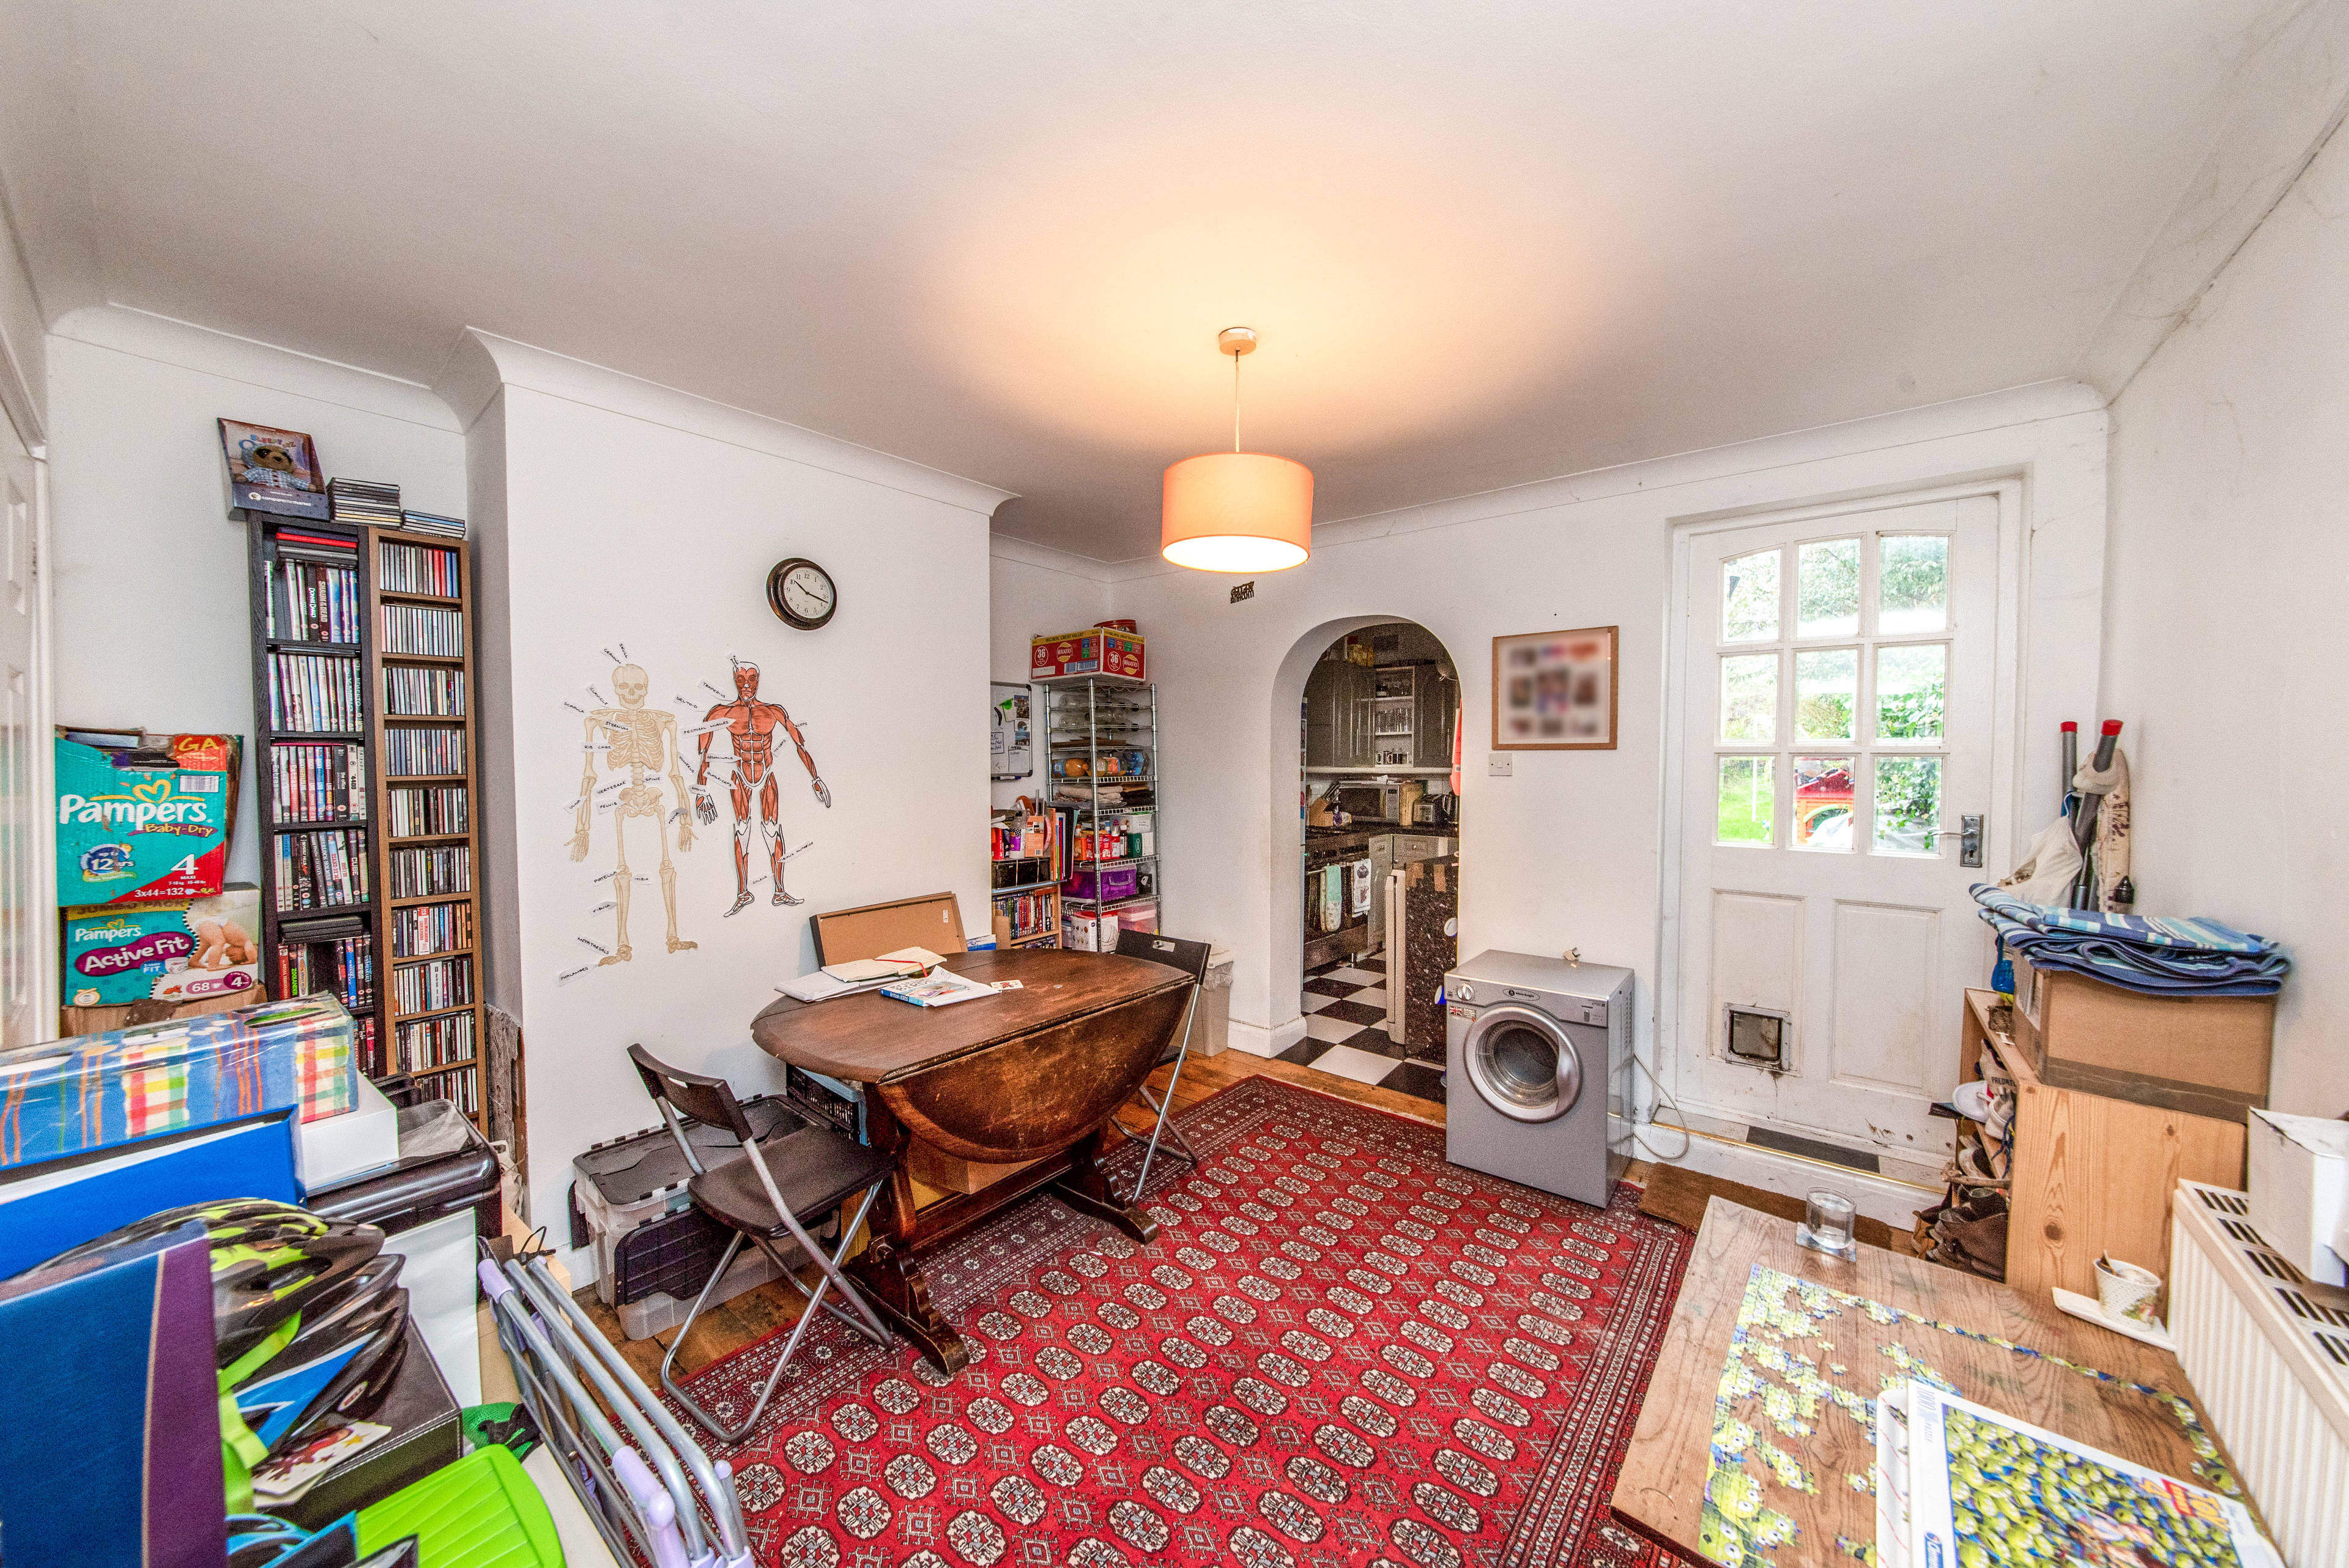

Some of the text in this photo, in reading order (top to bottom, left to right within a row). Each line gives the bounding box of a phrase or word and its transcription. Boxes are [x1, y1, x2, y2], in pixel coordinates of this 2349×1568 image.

[619, 643, 628, 659] SKULL
[1037, 648, 1045, 658] 36
[1110, 653, 1118, 664] 36
[589, 686, 609, 705] CLAVICLE
[676, 696, 698, 709] DELTOID
[605, 721, 629, 731] STERNUM
[597, 781, 626, 794] VERTEBRAE
[59, 794, 207, 831] Pampers
[145, 823, 213, 838] Baby-Dry
[91, 858, 114, 871] 12
[170, 853, 199, 875] 4
[594, 871, 618, 883] PATELLA
[134, 888, 184, 897] 3x44=132
[593, 904, 611, 913] FIBULA
[75, 926, 142, 942] Pampers
[84, 937, 190, 972] Active Fit
[192, 982, 210, 992] 68
[231, 977, 243, 987] 4
[1917, 1386, 1936, 1411] 1000
[2139, 1478, 2172, 1499] 4
[2188, 1490, 2230, 1531] TOY
